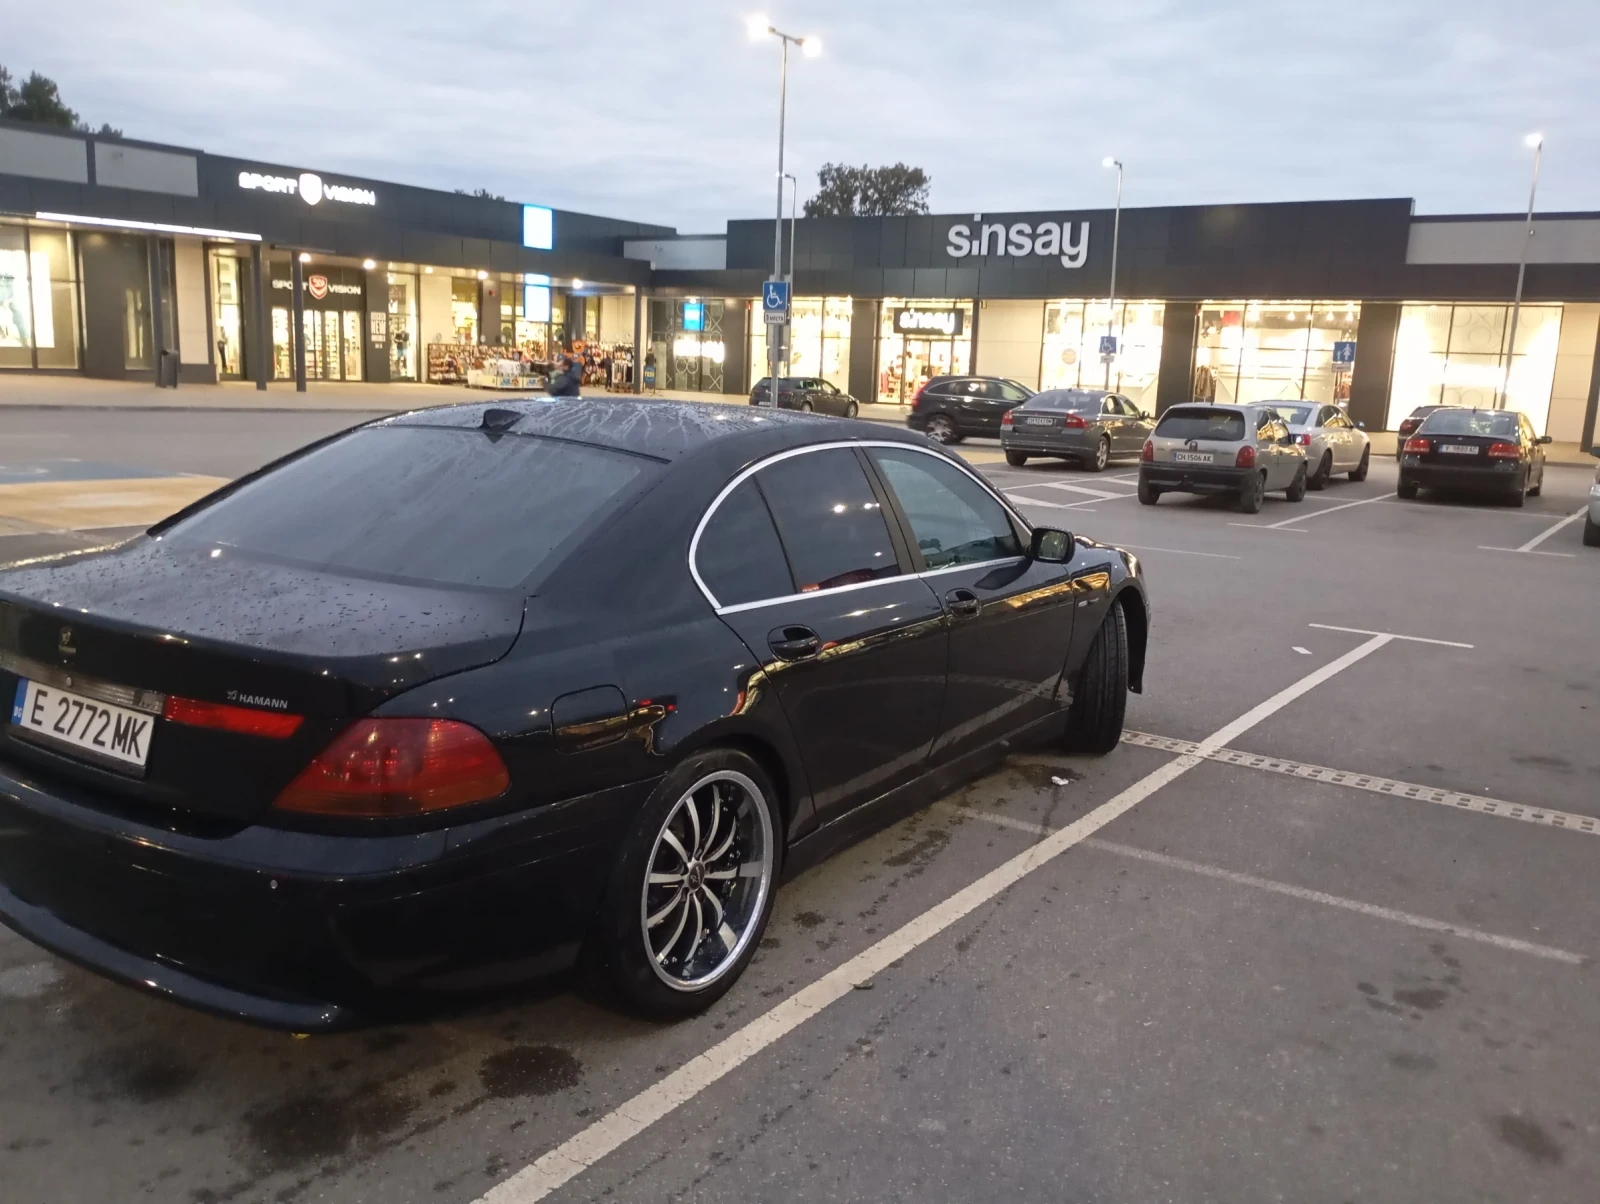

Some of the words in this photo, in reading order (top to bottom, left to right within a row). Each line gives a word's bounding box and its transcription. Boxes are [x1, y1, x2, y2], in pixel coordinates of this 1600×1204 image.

[238, 171, 298, 194] SPORT
[323, 183, 376, 206] VISION
[946, 213, 1090, 268] sinsay
[272, 279, 308, 291] SPOT
[328, 284, 361, 295] VISION
[1177, 453, 1186, 461] CH
[1187, 454, 1202, 462] 1506
[30, 688, 48, 726] E
[239, 693, 288, 709] HAMANN
[13, 705, 22, 718] BG
